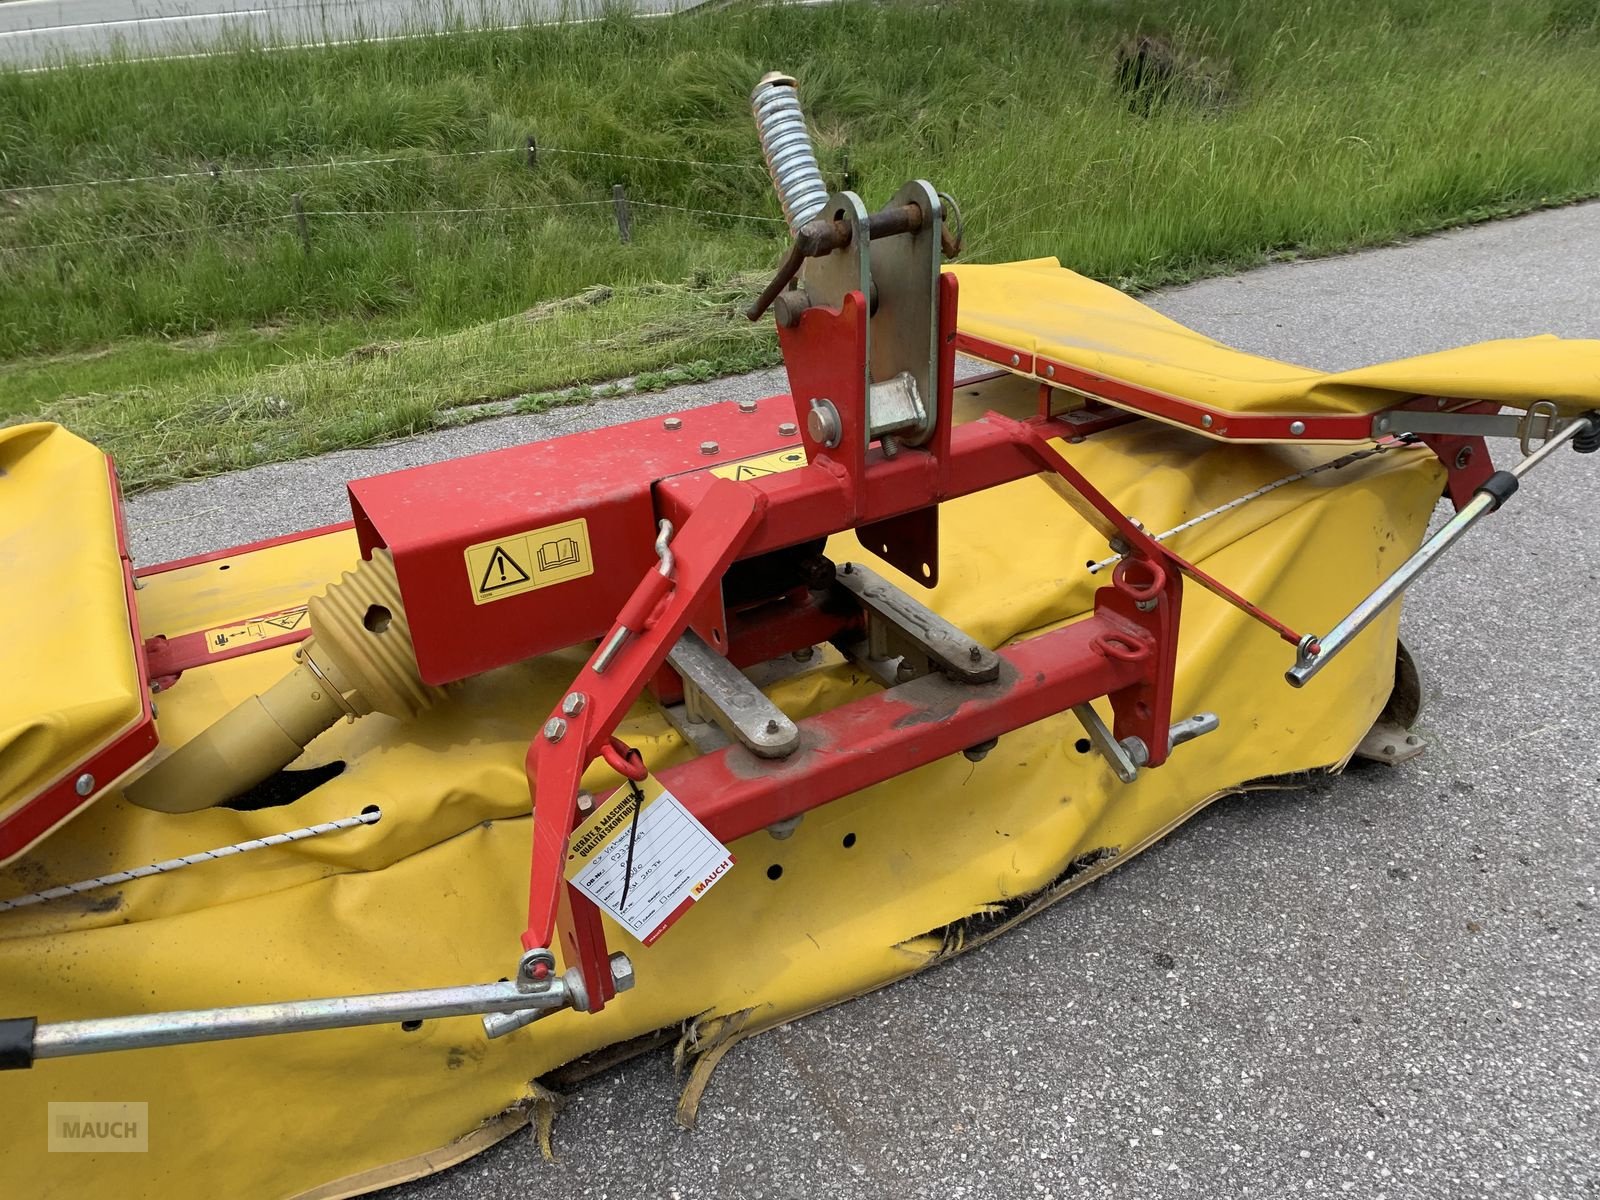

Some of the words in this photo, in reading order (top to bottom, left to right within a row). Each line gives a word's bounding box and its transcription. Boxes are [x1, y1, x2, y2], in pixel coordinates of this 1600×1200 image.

[569, 828, 597, 853] GERÄTE
[593, 823, 603, 832] &
[598, 791, 636, 826] MASCHINEN
[577, 796, 643, 858] QUALITÄTSKONTROLL
[694, 859, 730, 894] MAUCH
